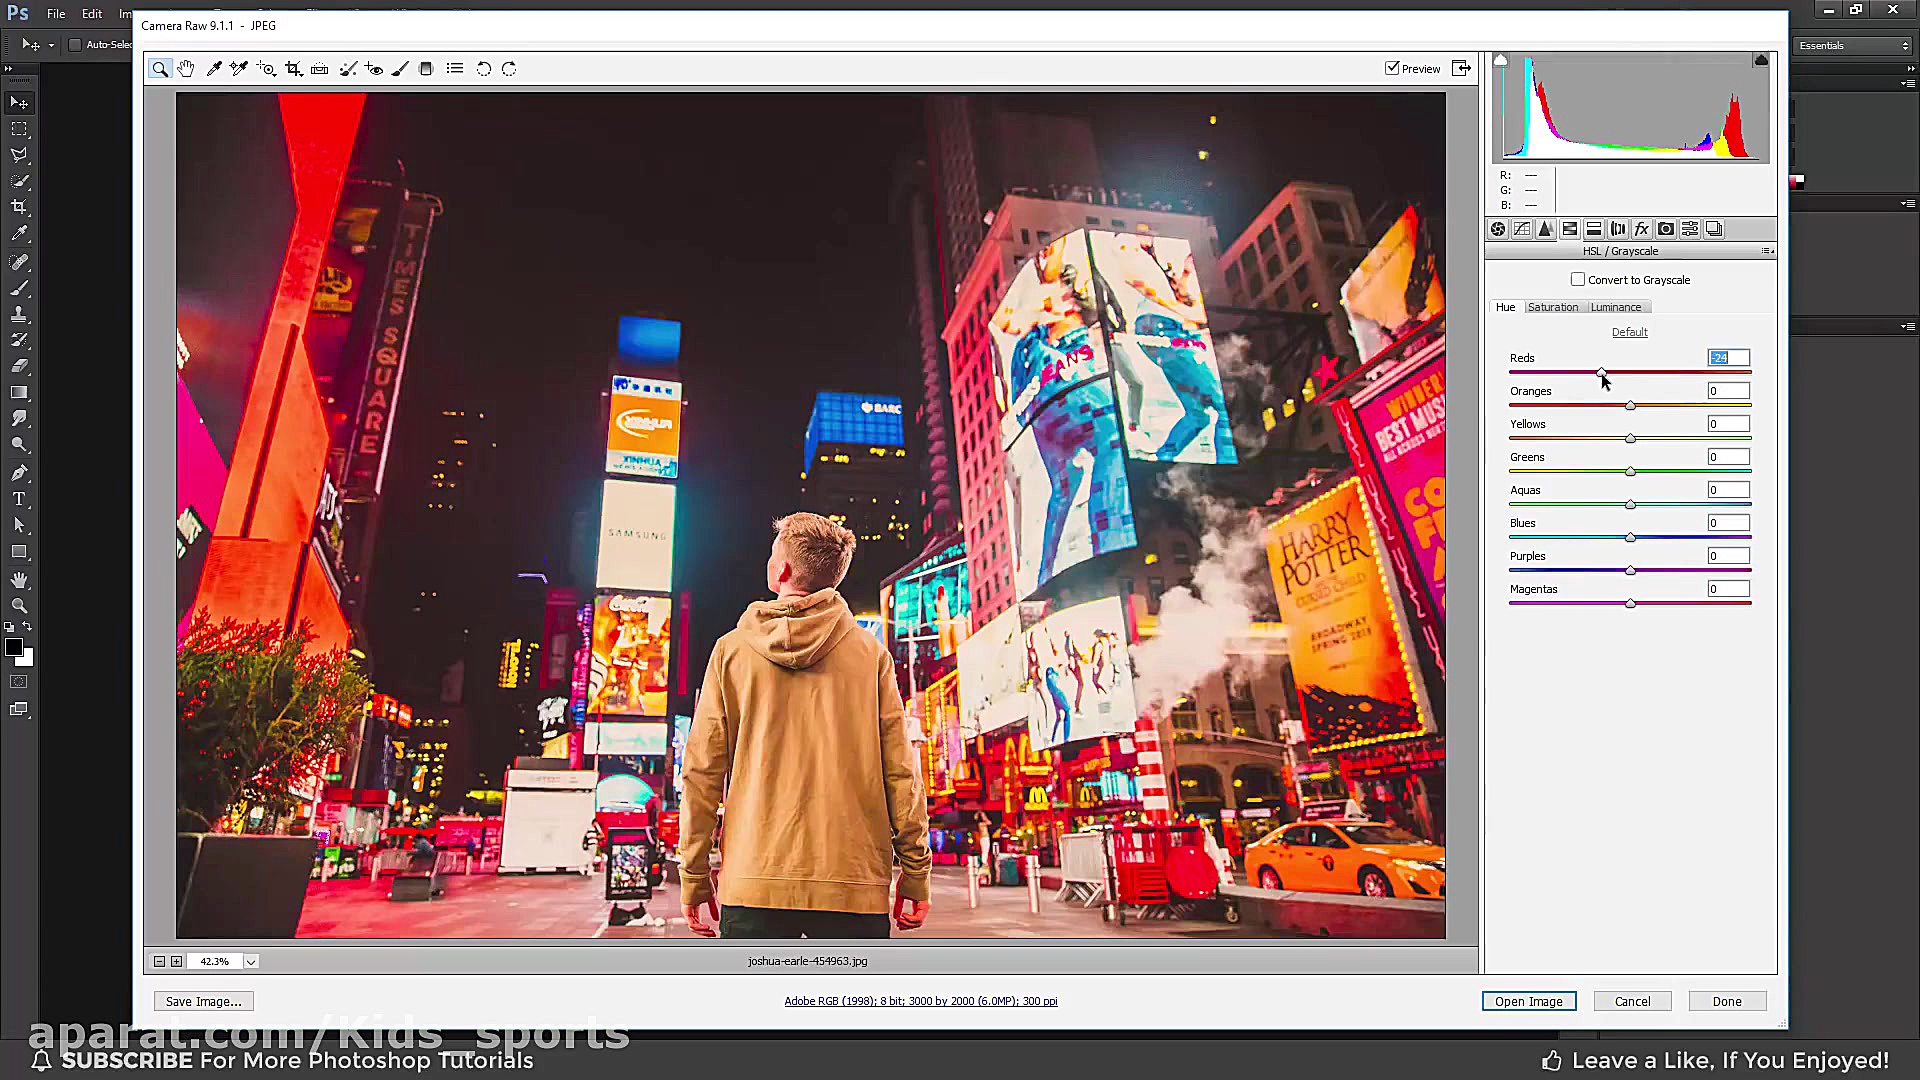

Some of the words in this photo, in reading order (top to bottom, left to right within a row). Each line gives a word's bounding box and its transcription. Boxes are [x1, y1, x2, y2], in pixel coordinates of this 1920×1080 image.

[7, 4, 29, 21] Ps
[47, 8, 66, 19] File
[82, 8, 103, 19] Edit
[141, 20, 182, 31] Camera
[185, 20, 207, 31] Raw
[210, 20, 233, 31] 9.1.1
[251, 20, 276, 31] JPEG
[1799, 41, 1845, 51] Essentials
[1402, 64, 1441, 74] Preview
[1500, 170, 1511, 180] R:
[1500, 185, 1511, 195] G:
[1501, 200, 1511, 210] B:
[1583, 246, 1603, 257] HSL
[1611, 246, 1659, 259] Grayscale
[388, 222, 424, 316] TIMES
[1588, 275, 1629, 285] Convert
[1631, 275, 1641, 285] to
[1643, 275, 1691, 287] Grayscale
[1496, 302, 1516, 312] Hue
[1528, 302, 1579, 312] Saturation
[1591, 302, 1642, 312] Luminance
[1612, 326, 1649, 338] Default
[1510, 352, 1535, 363] Reds
[1711, 353, 1728, 363] -24
[359, 326, 399, 454] SQUARE
[1510, 386, 1552, 398] Oranges
[1710, 386, 1717, 396] 0
[1510, 418, 1546, 429] Yellows
[1710, 419, 1717, 429] 0
[1374, 416, 1411, 452] BEST
[1510, 452, 1545, 462] Greens
[1710, 452, 1717, 462] 0
[1510, 485, 1541, 497] Aquas
[1710, 485, 1717, 495] 0
[1510, 517, 1536, 528] Blues
[1710, 518, 1717, 528] 0
[607, 527, 667, 541] SAMSUNG
[1279, 502, 1352, 564] HARRY
[1510, 550, 1546, 563] Purples
[1710, 551, 1717, 561] 0
[1280, 534, 1371, 596] POTTER
[1510, 584, 1558, 596] Magentas
[1710, 584, 1717, 594] 0
[1311, 615, 1368, 642] BROADWAY
[200, 957, 230, 967] 42.3%
[747, 955, 868, 968] joshua-earle-454963.jpg
[166, 996, 192, 1007] Save
[196, 996, 242, 1009] Image...
[785, 996, 817, 1007] Adobe
[818, 996, 840, 1007] RGB
[842, 996, 878, 1008] (1998);
[880, 996, 887, 1007] 8
[889, 996, 906, 1007] bit;
[908, 996, 934, 1007] 3000
[935, 996, 948, 1008] by
[951, 996, 976, 1007] 2000
[978, 996, 1020, 1008] (6.0MP);
[1022, 996, 1041, 1007] 300
[1043, 996, 1058, 1008] ppi
[1495, 996, 1525, 1008] Open
[1528, 996, 1563, 1009] Image
[1614, 996, 1651, 1007] Cancel
[1712, 996, 1742, 1007] Done
